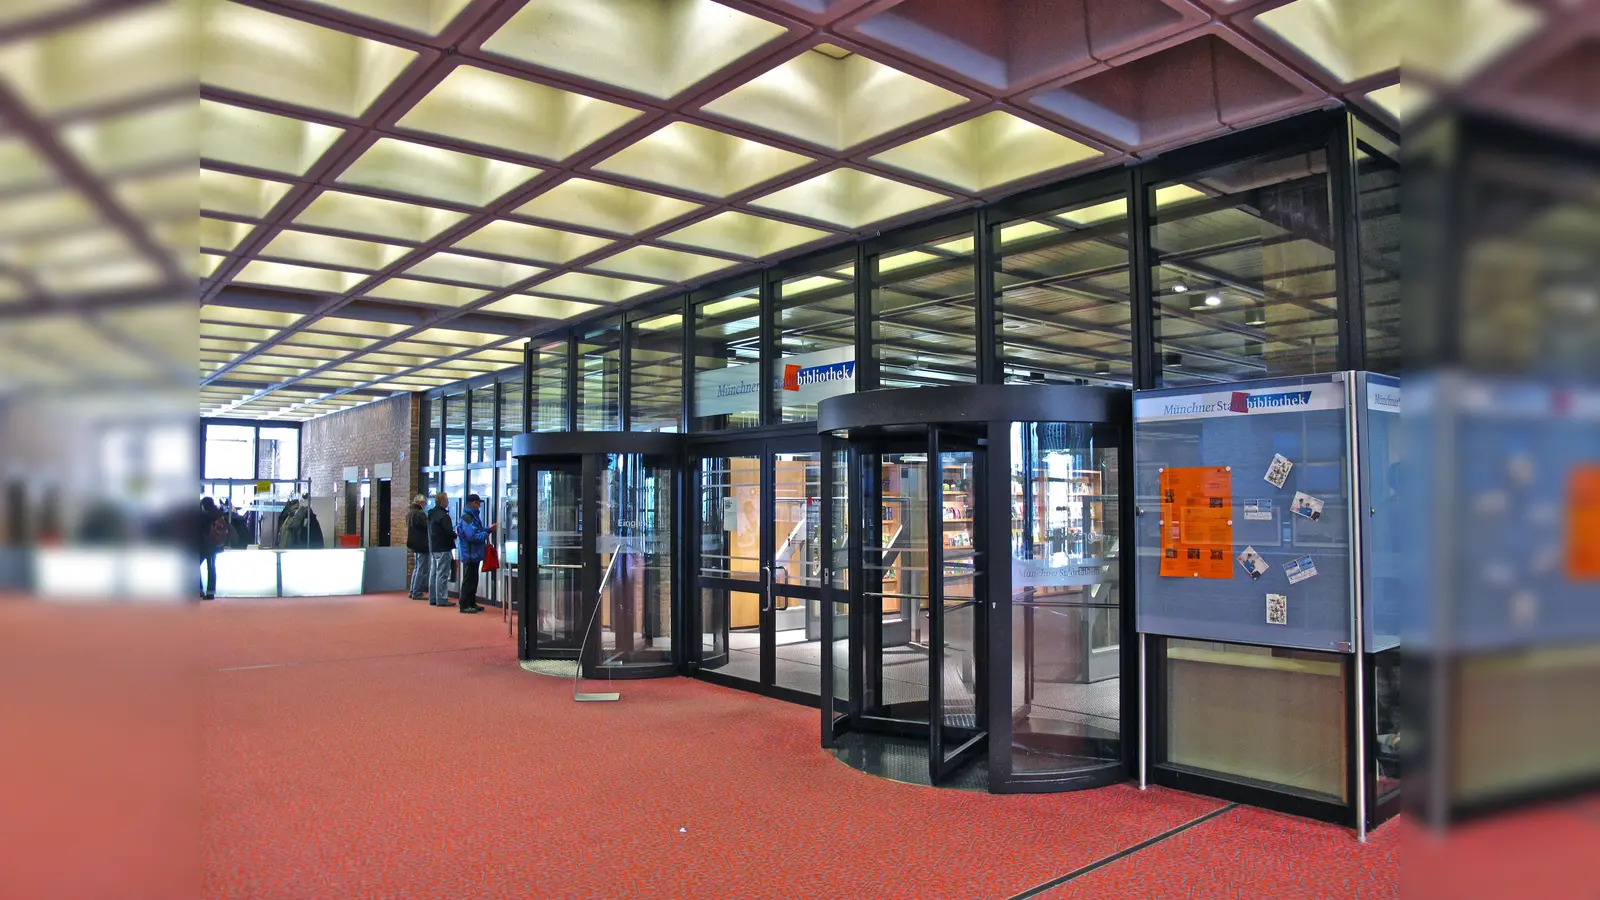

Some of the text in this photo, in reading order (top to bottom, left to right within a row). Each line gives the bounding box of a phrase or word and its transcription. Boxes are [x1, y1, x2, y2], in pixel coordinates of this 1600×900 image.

[717, 380, 760, 397] Münchner
[1163, 393, 1306, 416] Münchner Stabibliothek
